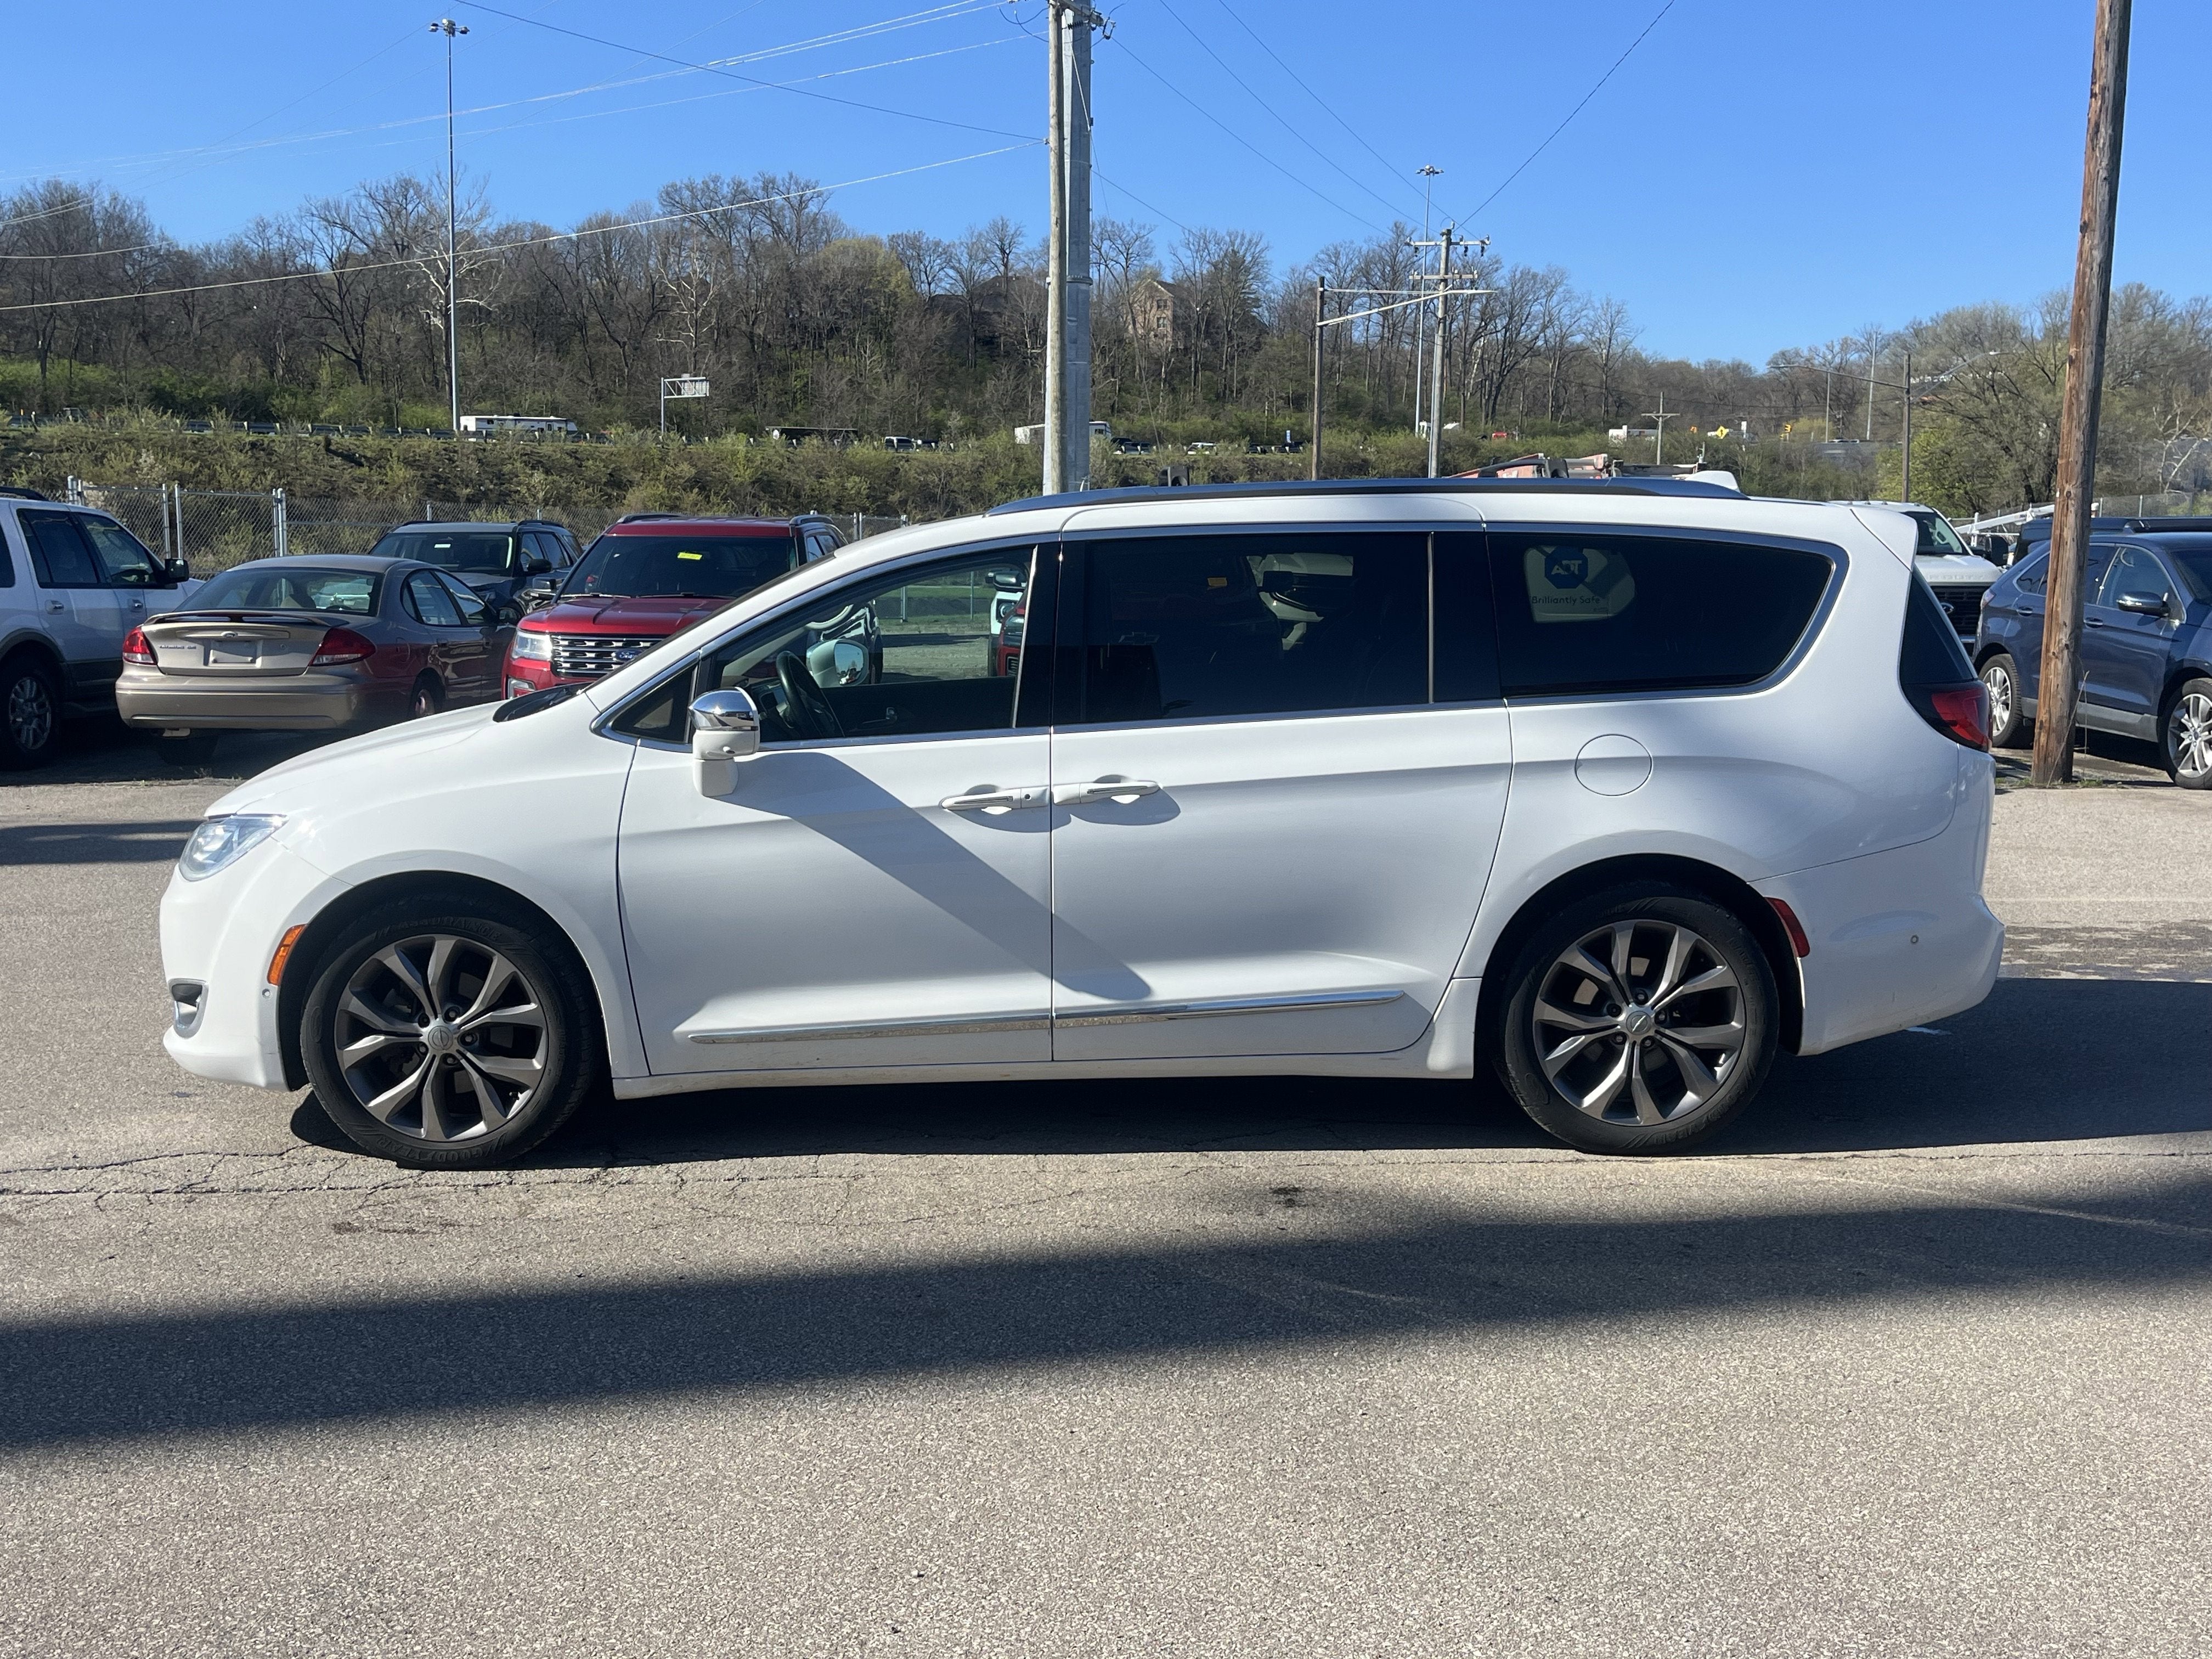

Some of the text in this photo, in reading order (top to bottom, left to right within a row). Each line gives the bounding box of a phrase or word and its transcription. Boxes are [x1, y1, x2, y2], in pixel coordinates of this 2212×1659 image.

[1551, 560, 1582, 575] ADT
[1531, 595, 1600, 605] Brilliantly Safe
[376, 1135, 483, 1163] GOODYEAR
